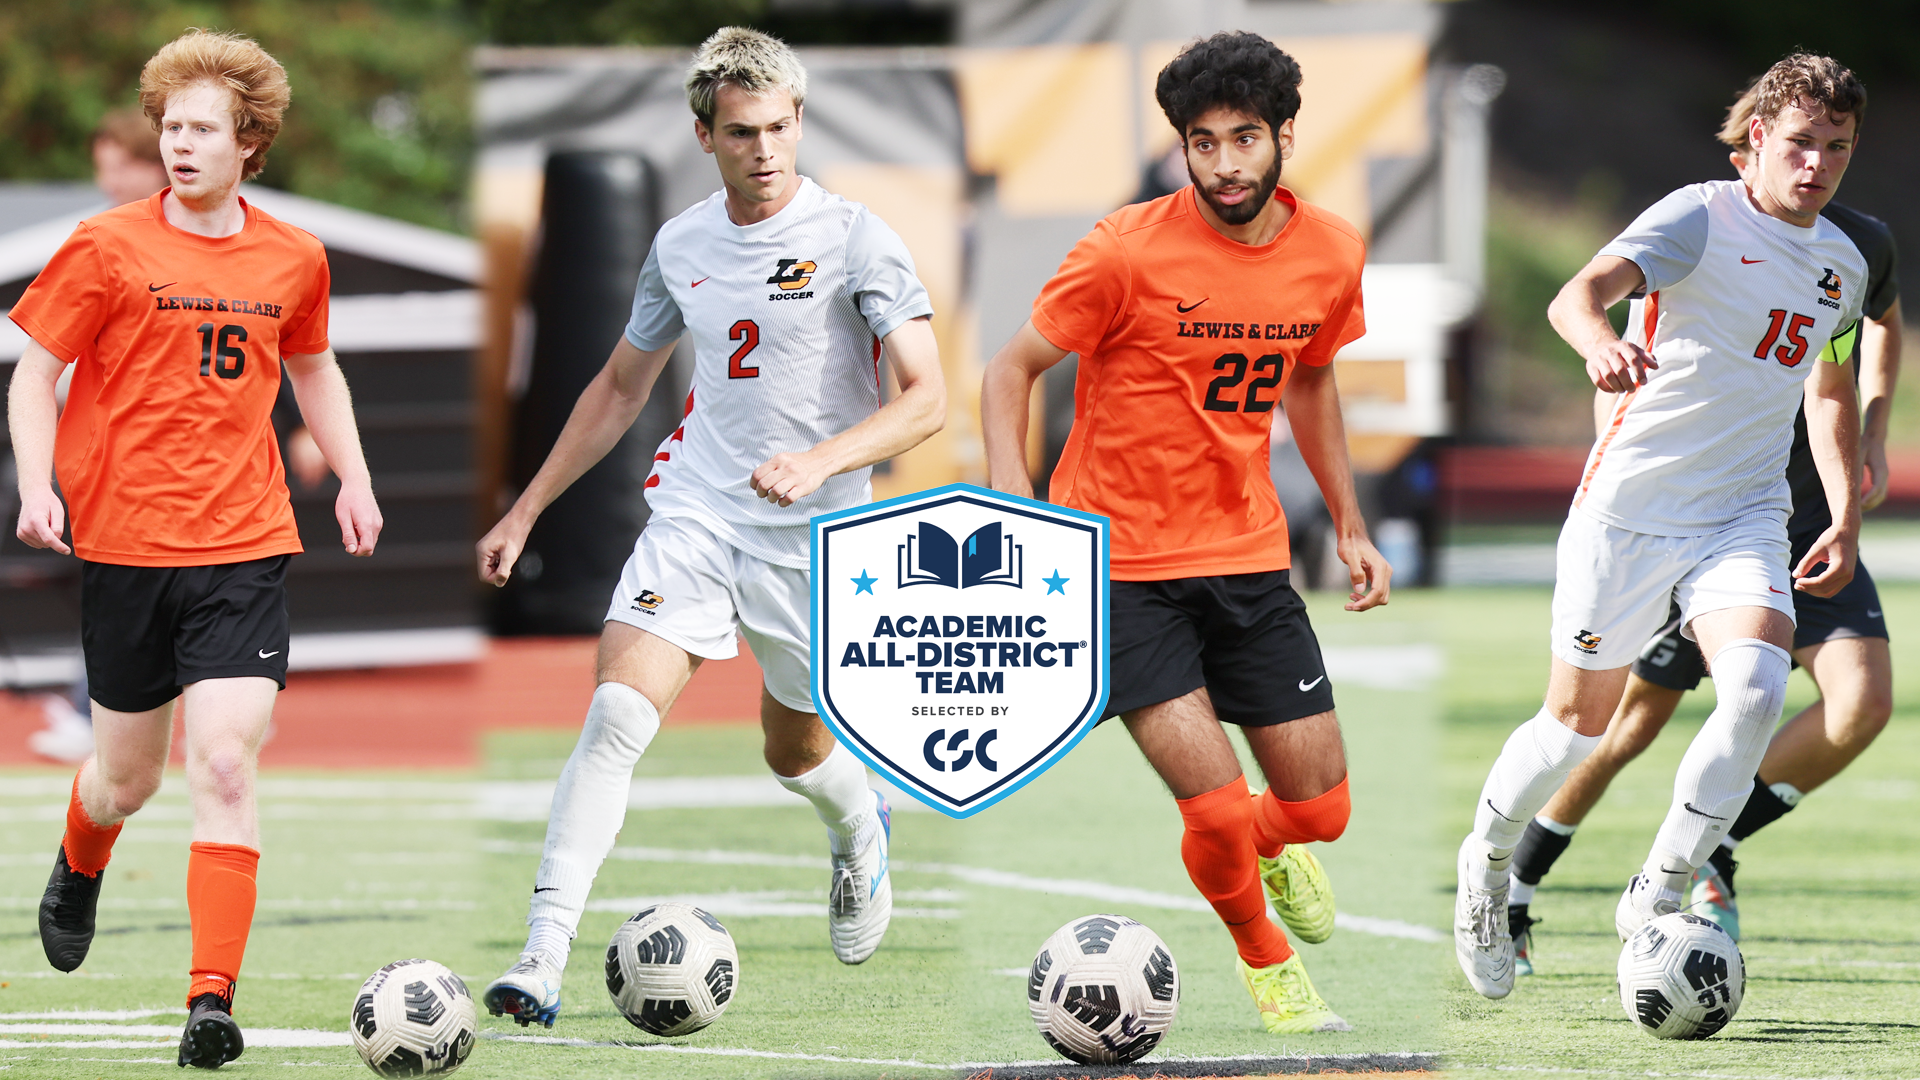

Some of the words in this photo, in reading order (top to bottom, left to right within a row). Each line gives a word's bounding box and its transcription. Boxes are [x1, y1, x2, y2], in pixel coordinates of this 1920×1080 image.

[156, 296, 213, 311] LEWIS
[216, 299, 229, 312] &
[232, 300, 283, 319] CLARK
[769, 291, 814, 301] SOCCER
[728, 319, 760, 379] 2
[1177, 321, 1245, 339] LEWIS
[1248, 323, 1261, 339] &
[1753, 309, 1815, 368] 15
[197, 323, 248, 379] 16
[1203, 353, 1285, 413] 22
[630, 605, 656, 616] SOCCER
